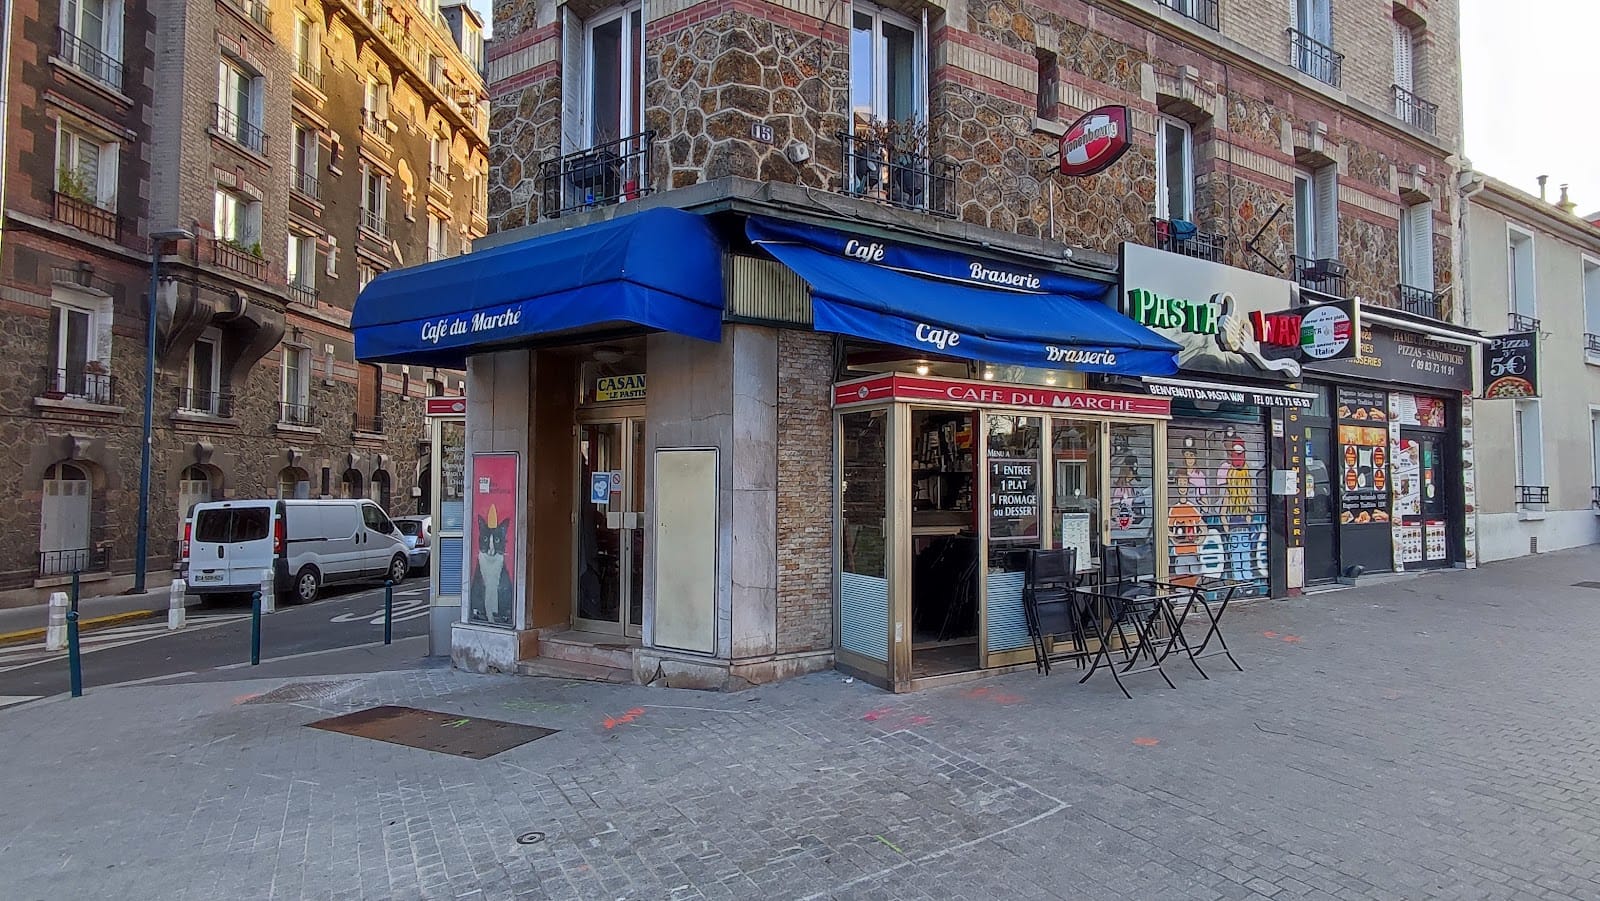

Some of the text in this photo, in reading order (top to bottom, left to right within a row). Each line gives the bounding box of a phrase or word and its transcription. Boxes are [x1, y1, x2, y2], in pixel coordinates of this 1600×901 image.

[754, 125, 771, 140] 15
[844, 240, 885, 262] Café
[969, 262, 1041, 289] Brasserie
[421, 304, 522, 344] Café du Marché
[1128, 288, 1301, 347] PASTA WAY
[1398, 344, 1422, 358] PIZZAS
[1490, 338, 1530, 350] Pizza
[1045, 346, 1117, 365] Brasserie
[1490, 355, 1527, 376] 5€
[946, 386, 1135, 411] CAFE DU MARCHE
[1149, 384, 1195, 399] BENVENUTI
[1195, 389, 1207, 400] DA
[1208, 390, 1230, 401] PASTA
[1230, 391, 1245, 403] WAY
[1253, 394, 1265, 405] TEL
[1265, 395, 1274, 406] 01
[1275, 396, 1284, 406] 41
[1284, 397, 1293, 406] 71
[993, 463, 1032, 475] 1 ENTREE
[1001, 479, 1028, 491] 1 PLAT
[991, 493, 1037, 505] 1 FROMAGE
[993, 506, 1037, 517] ou DESSERT
